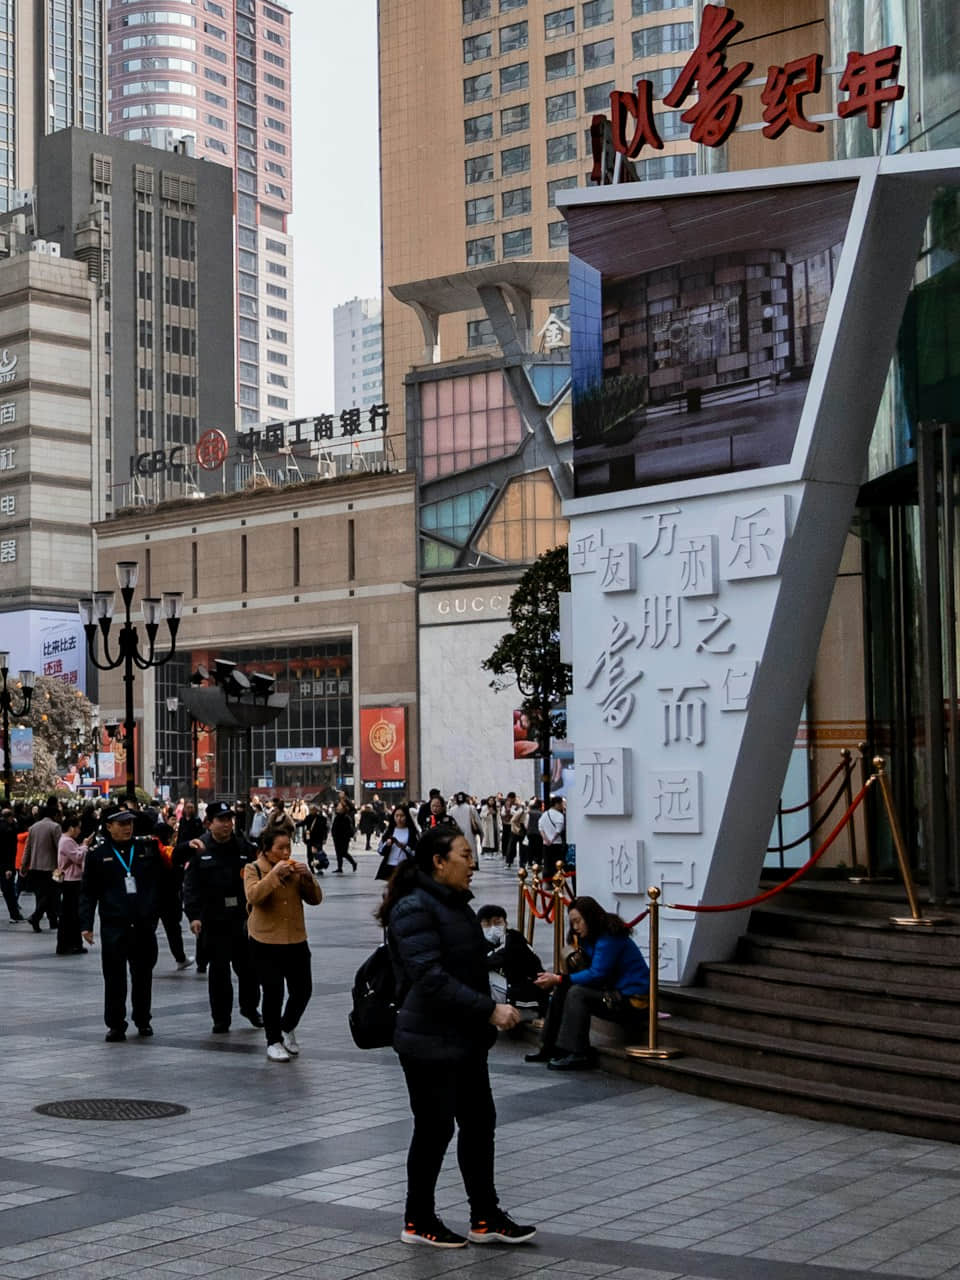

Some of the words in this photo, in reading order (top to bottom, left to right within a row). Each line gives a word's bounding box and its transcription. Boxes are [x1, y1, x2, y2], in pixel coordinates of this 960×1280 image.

[537, 313, 570, 347] 金
[130, 445, 185, 477] ICBC
[238, 403, 390, 451] 中国工商银行
[0, 402, 16, 563] 商社电器
[572, 533, 597, 568] 乎
[728, 507, 776, 569] 乐
[599, 548, 625, 587] 友
[680, 540, 706, 592] 亦
[43, 636, 77, 656] 比来比去
[636, 595, 682, 649] 朋
[696, 606, 736, 654] 之
[722, 668, 748, 706] 仁
[658, 680, 710, 747] 而
[580, 751, 616, 809] 亦
[650, 777, 694, 822] 远
[608, 843, 632, 887] 论
